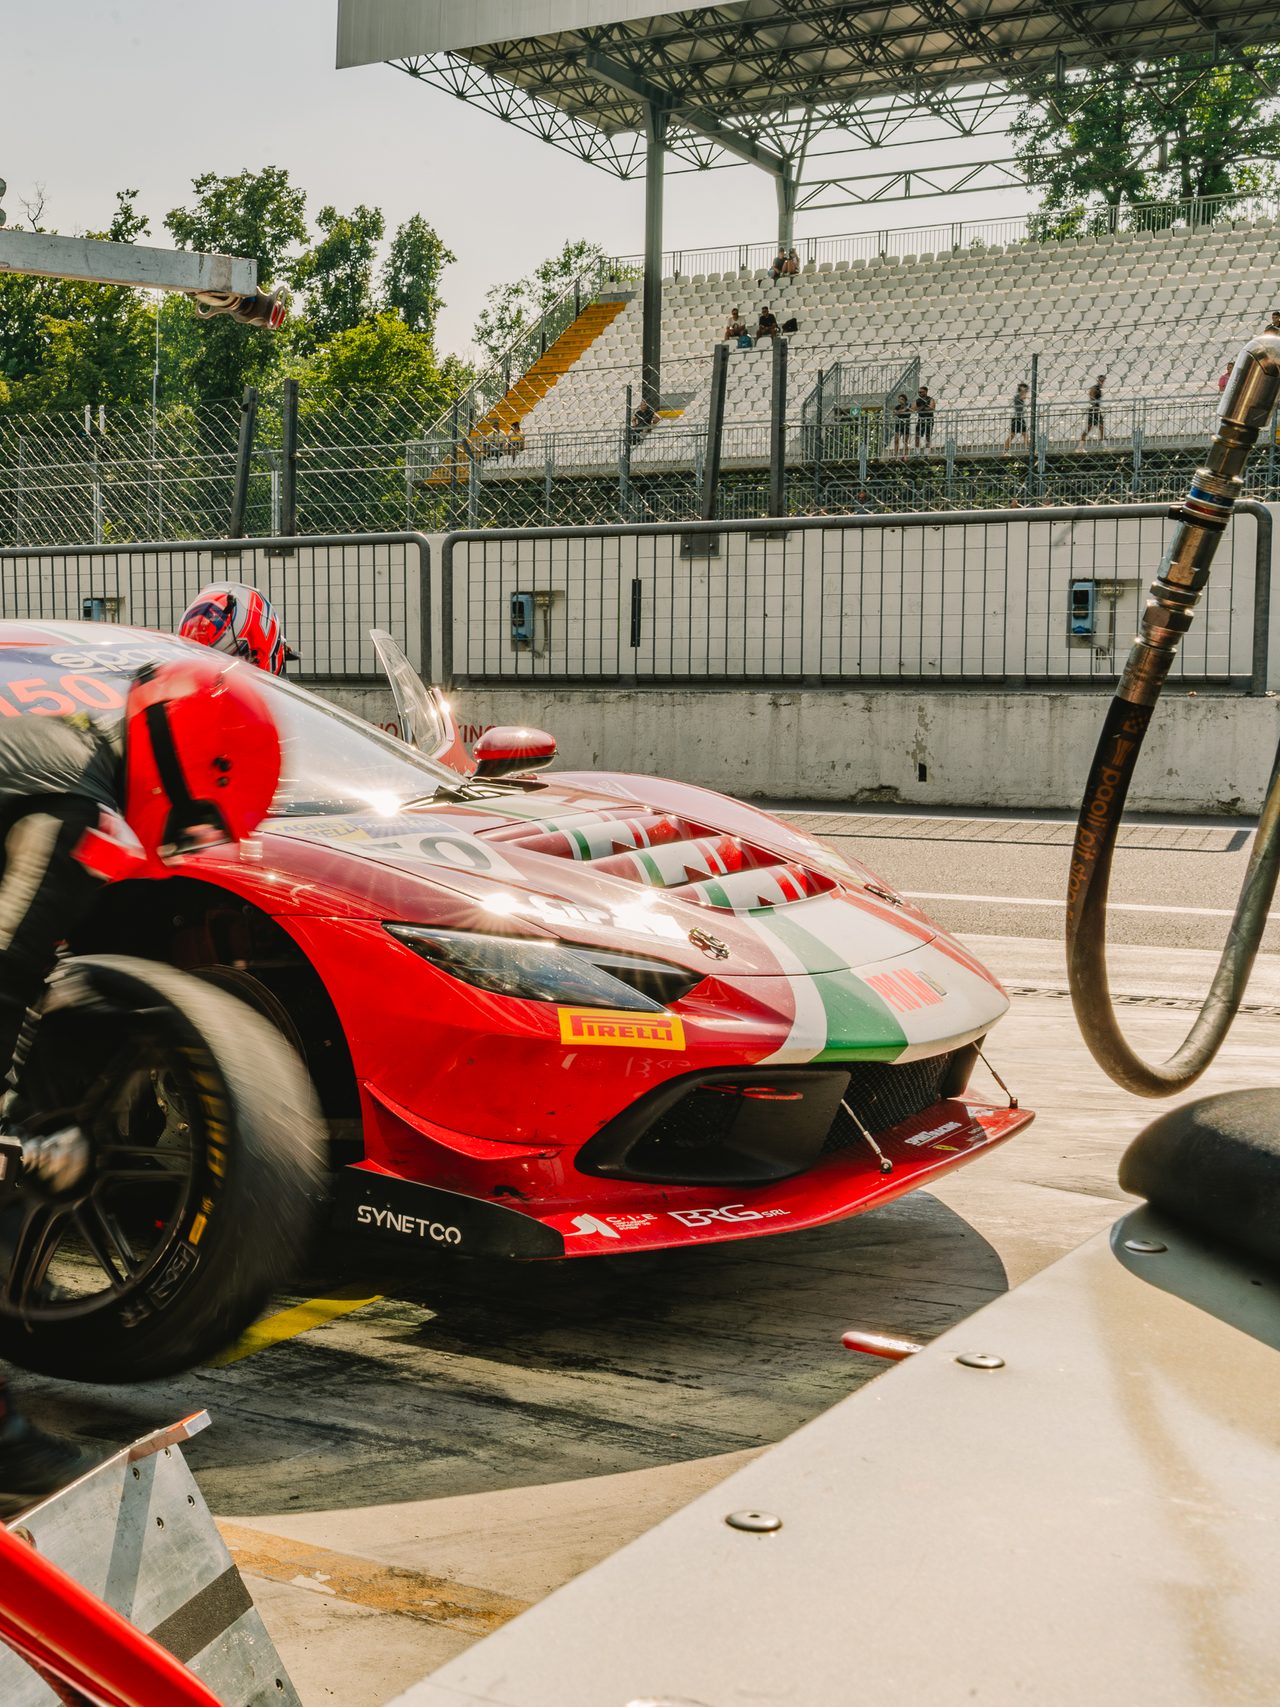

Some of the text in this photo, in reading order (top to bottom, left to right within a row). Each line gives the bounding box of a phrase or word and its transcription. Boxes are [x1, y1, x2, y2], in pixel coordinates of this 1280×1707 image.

[1086, 766, 1121, 827] paoli
[1076, 827, 1097, 861] pit
[570, 1015, 673, 1041] PIRELLI
[357, 1204, 462, 1245] SYNETCO
[667, 1204, 764, 1228] BRG
[761, 1208, 791, 1219] SRL
